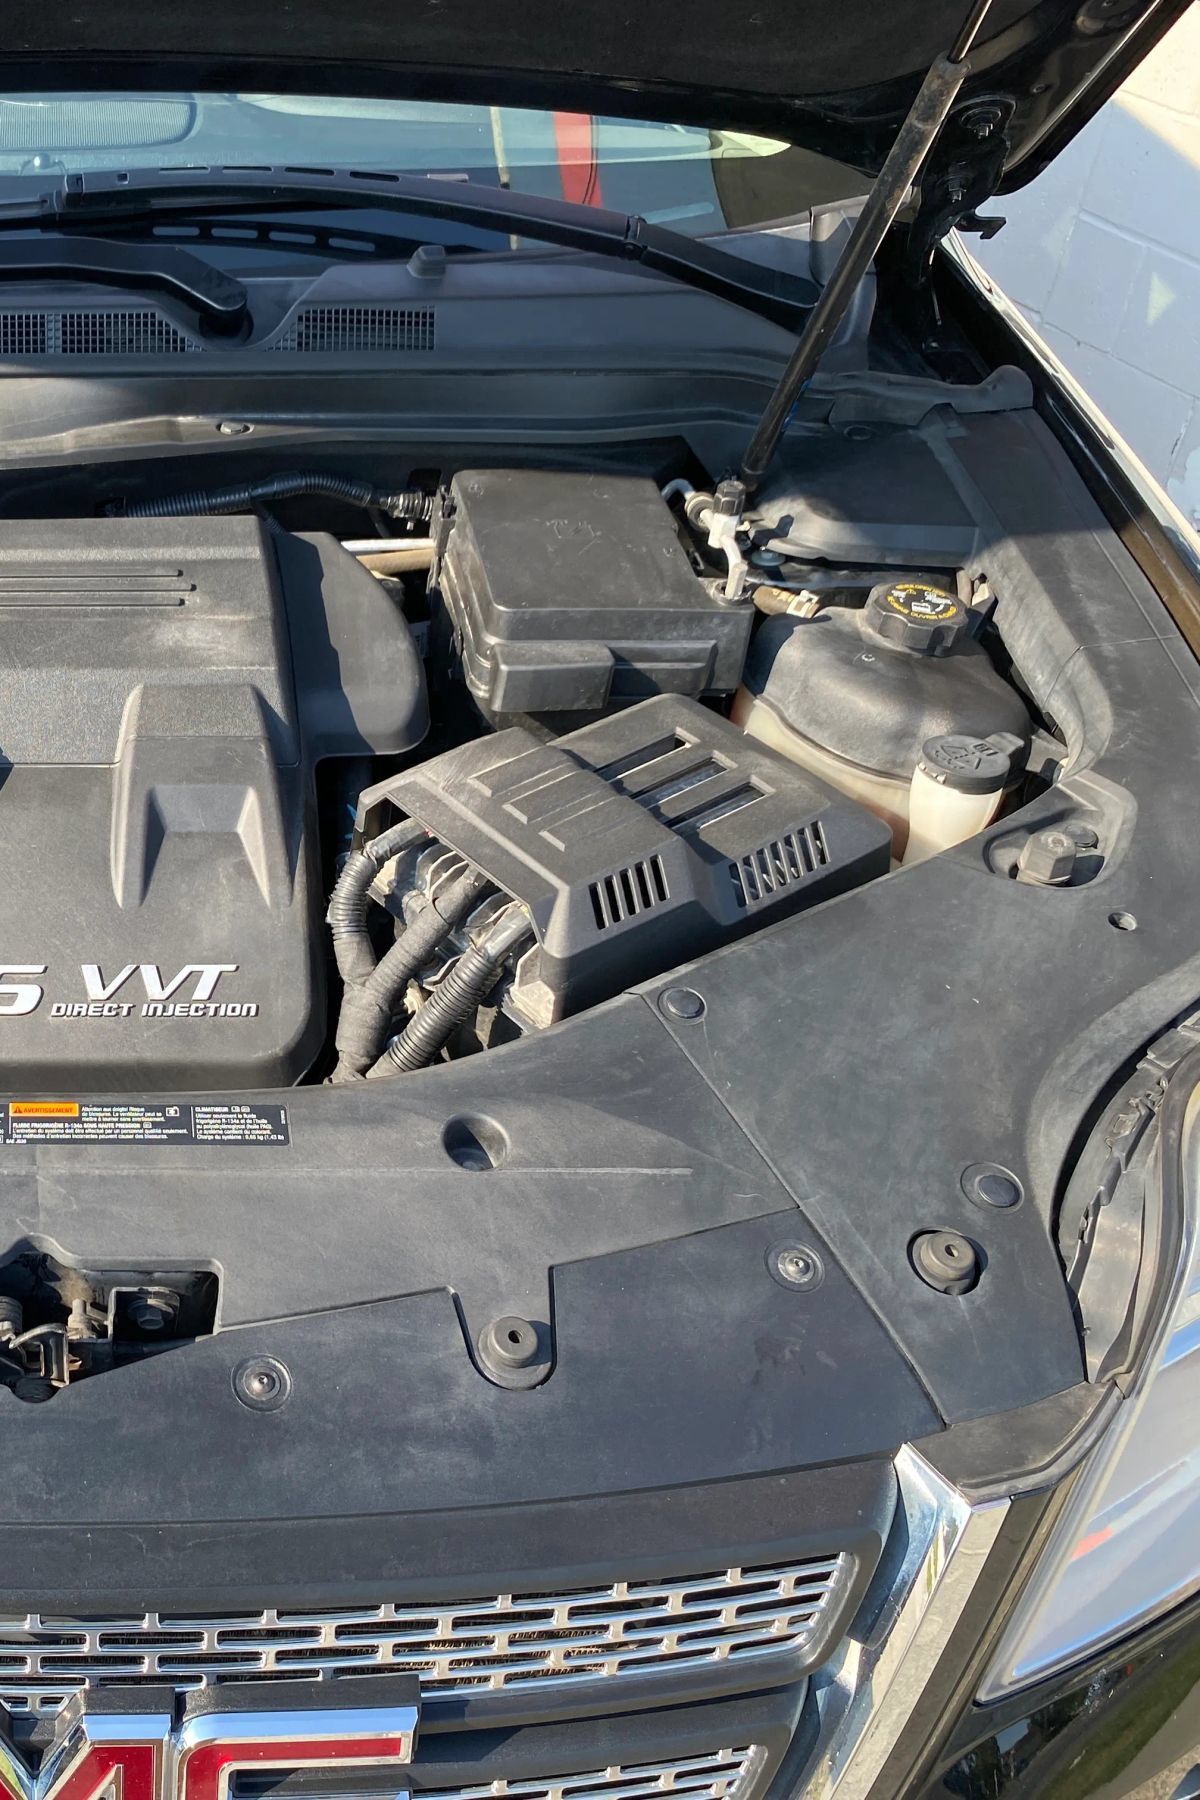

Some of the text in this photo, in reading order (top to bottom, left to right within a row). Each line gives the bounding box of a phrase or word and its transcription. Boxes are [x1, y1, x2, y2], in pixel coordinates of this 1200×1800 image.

[80, 964, 239, 1001] VVT
[50, 1003, 260, 1017] DIRECT INJECTION
